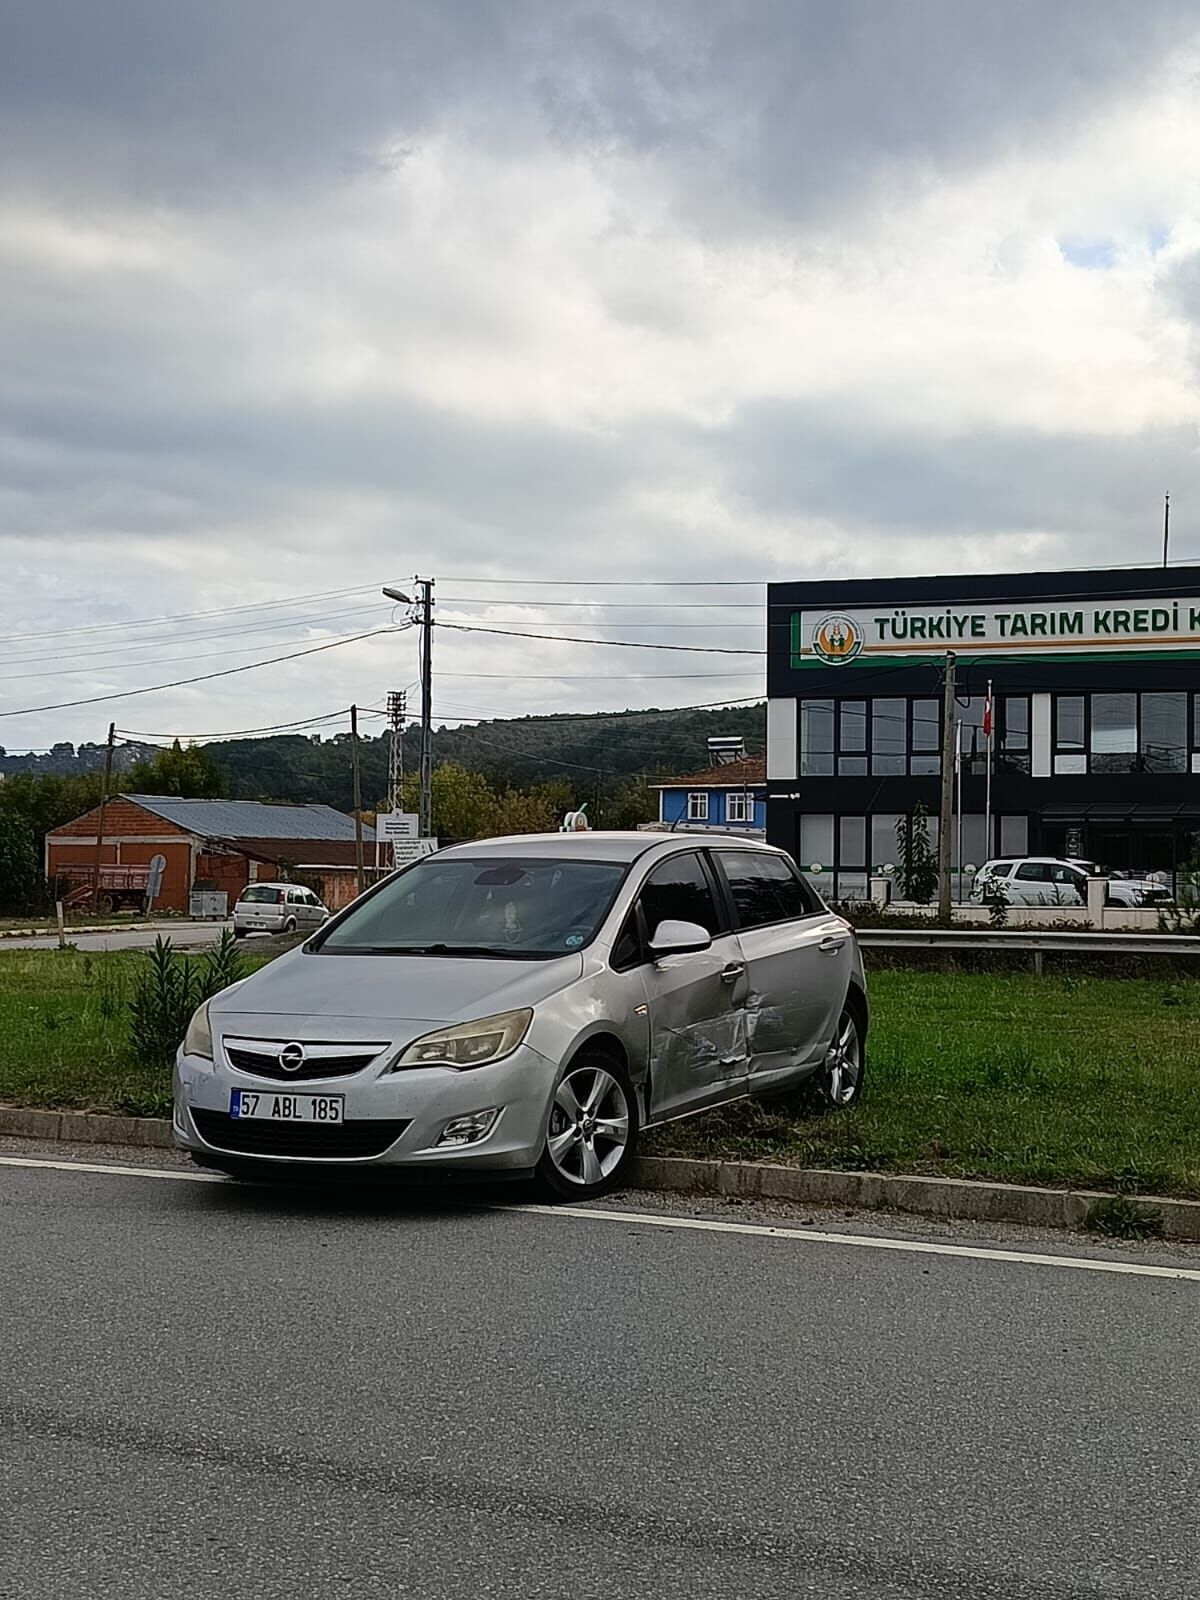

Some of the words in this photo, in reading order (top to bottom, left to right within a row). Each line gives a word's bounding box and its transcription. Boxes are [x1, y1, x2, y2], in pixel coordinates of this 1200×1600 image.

[874, 609, 986, 640] TÜRKİYE
[994, 611, 1083, 637] TARIM
[1094, 601, 1179, 634] KREDİ
[241, 1094, 260, 1116] 57
[271, 1096, 303, 1119] ABL
[311, 1098, 340, 1121] 185
